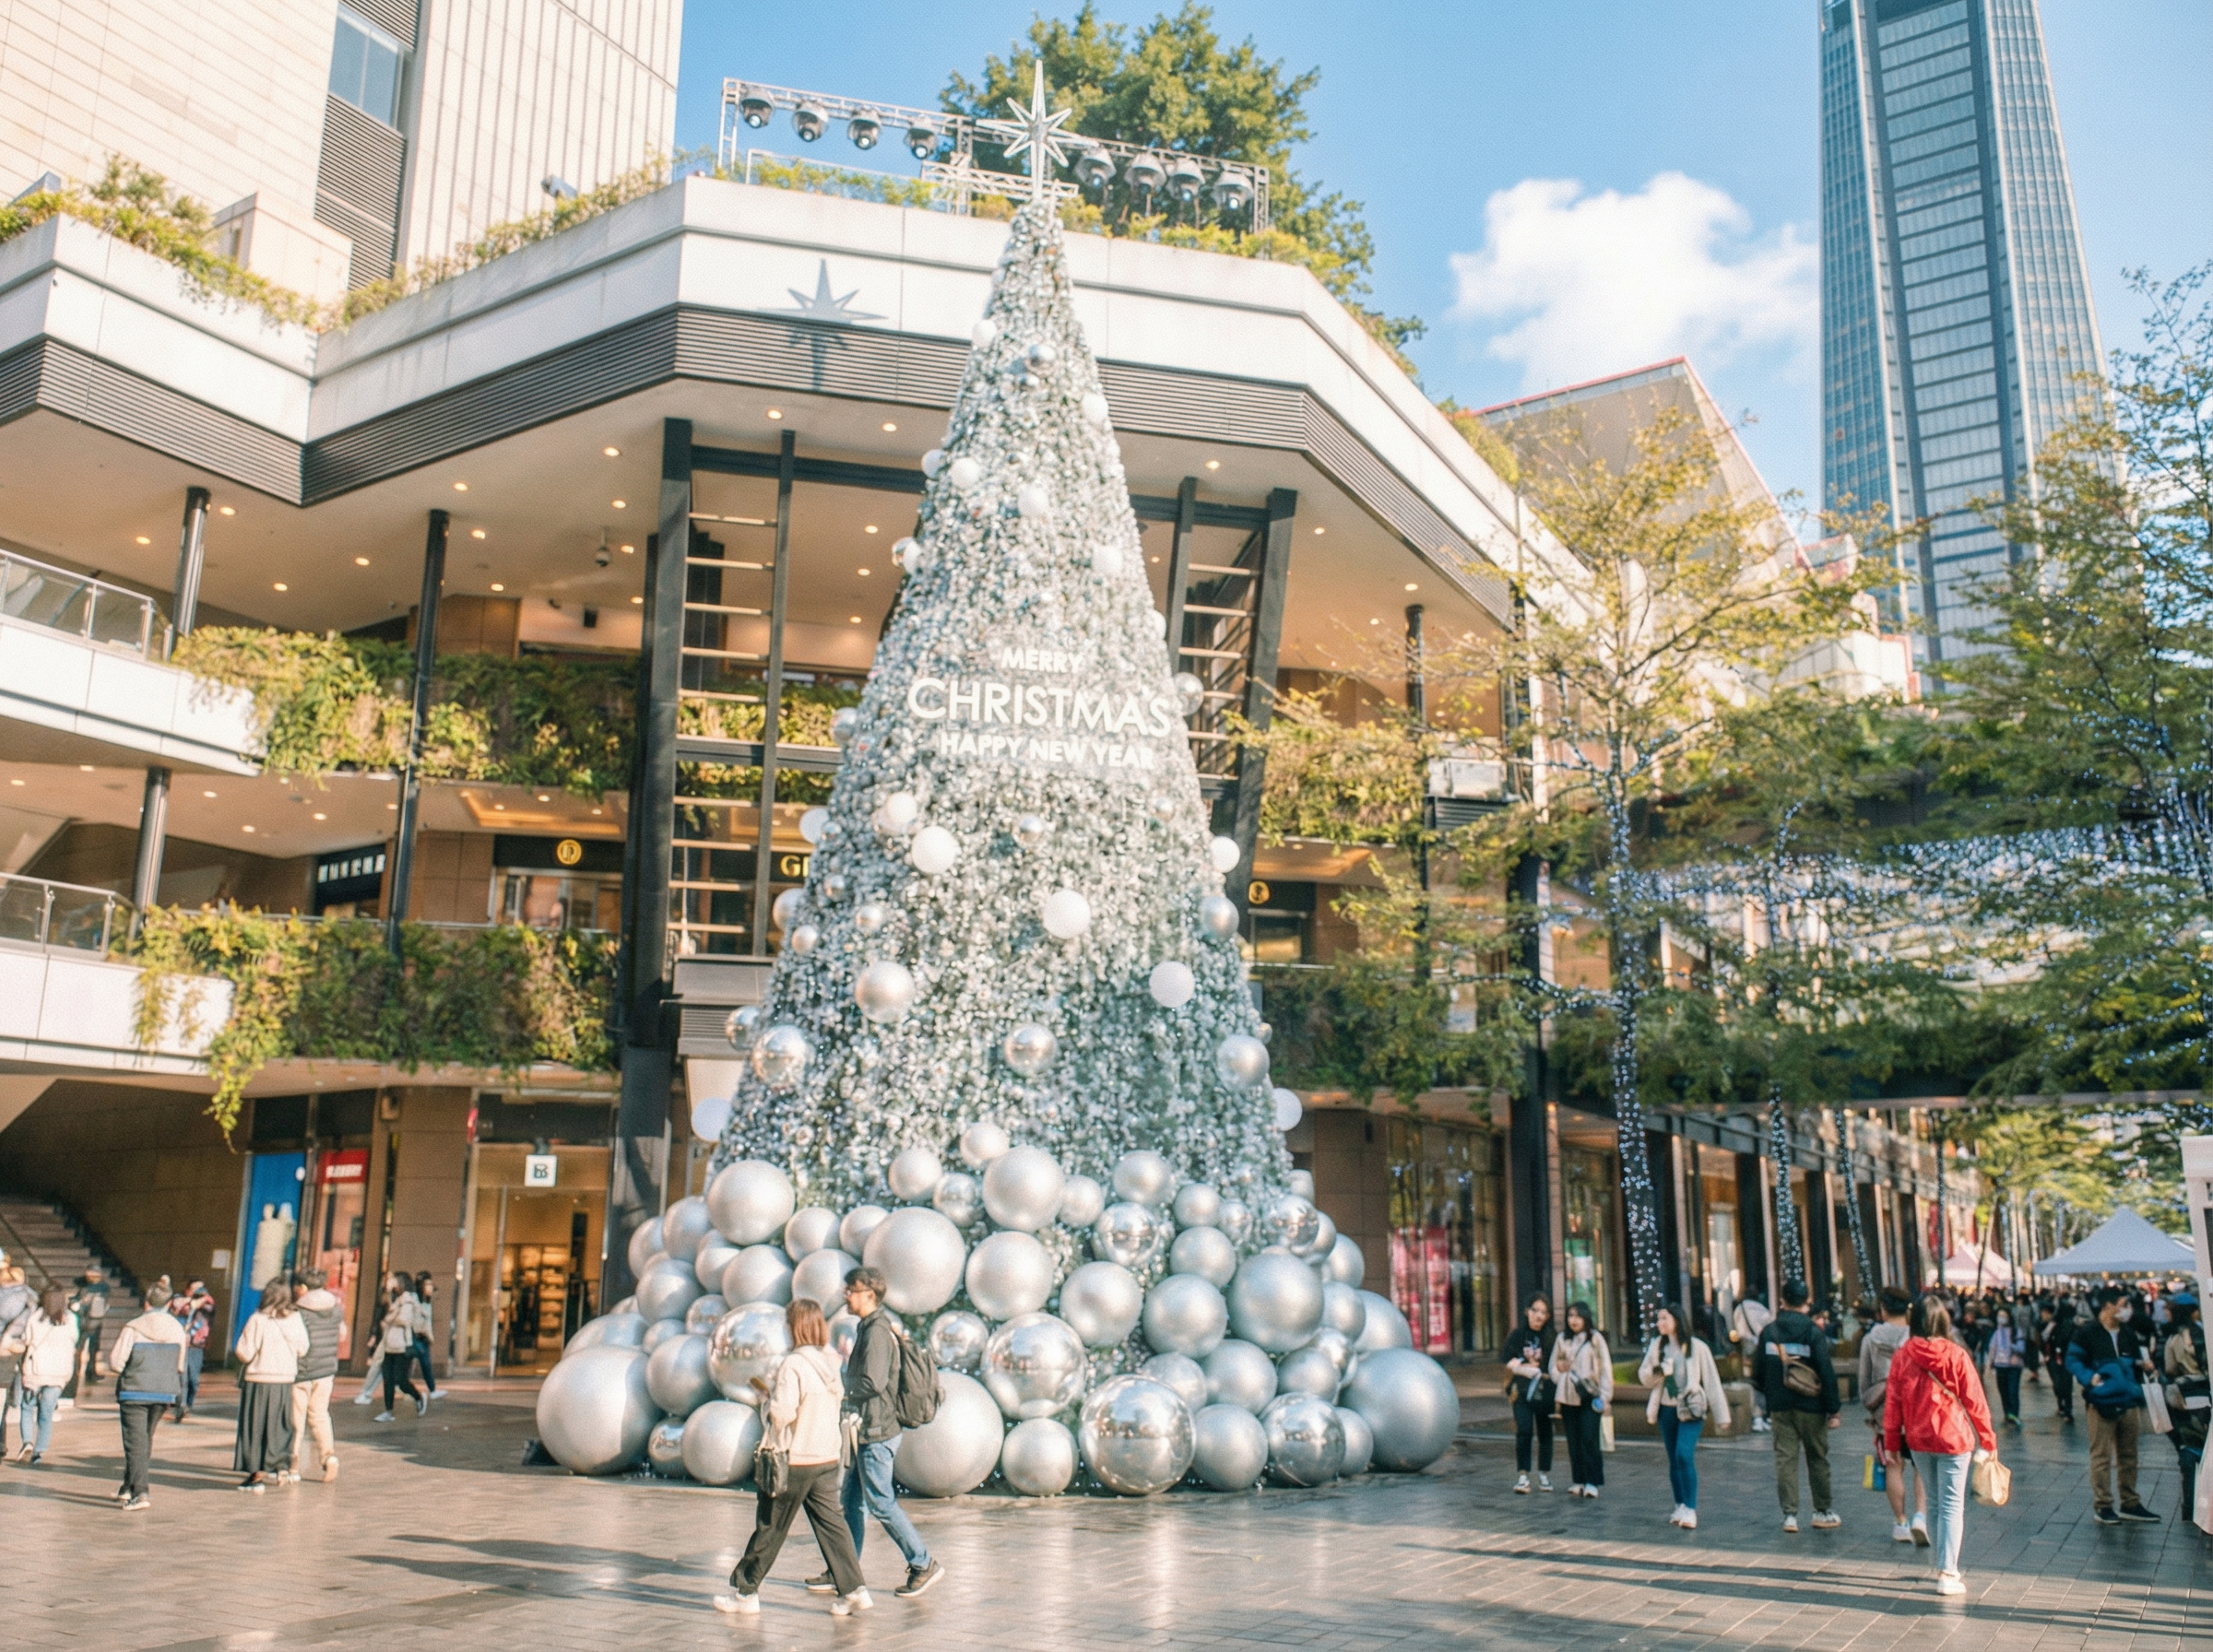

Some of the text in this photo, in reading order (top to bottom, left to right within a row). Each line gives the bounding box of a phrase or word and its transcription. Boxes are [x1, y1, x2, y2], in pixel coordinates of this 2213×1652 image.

[1001, 647, 1083, 674] MERRY
[907, 678, 1171, 738] CHRISTMAS
[940, 733, 1154, 769] HAPPY NEW YEAR
